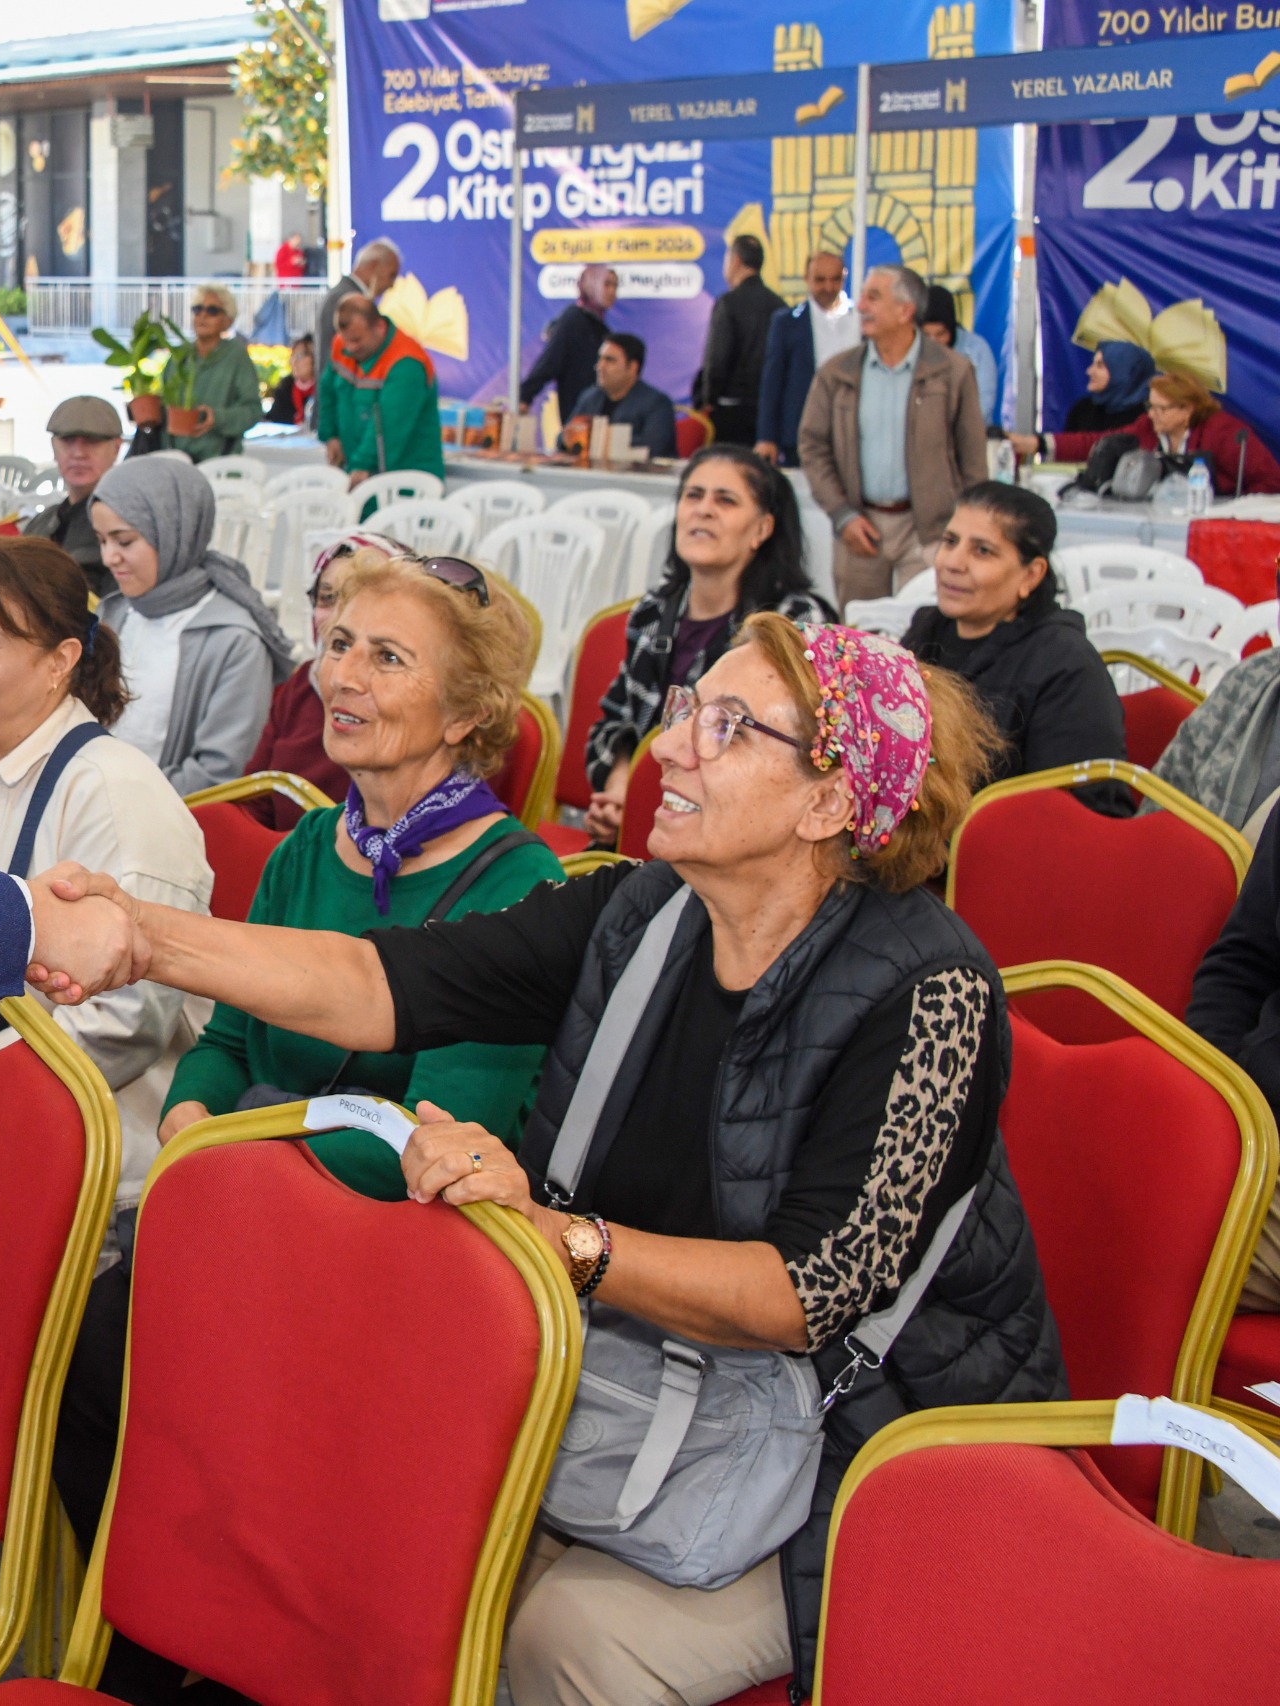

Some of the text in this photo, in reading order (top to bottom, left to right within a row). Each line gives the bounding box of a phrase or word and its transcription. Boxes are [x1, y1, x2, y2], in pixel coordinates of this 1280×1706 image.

[1098, 10, 1151, 37] 700
[1159, 5, 1228, 34] Yıldır
[382, 69, 416, 91] 700
[1011, 68, 1173, 99] YEREL YAZARLAR
[383, 90, 463, 116] Edebiyat,
[628, 98, 758, 123] YEREL YAZARLAR
[380, 121, 447, 223] 2.
[447, 162, 705, 231] Kitap Günleri
[1165, 1420, 1236, 1463] PROTOKOL
